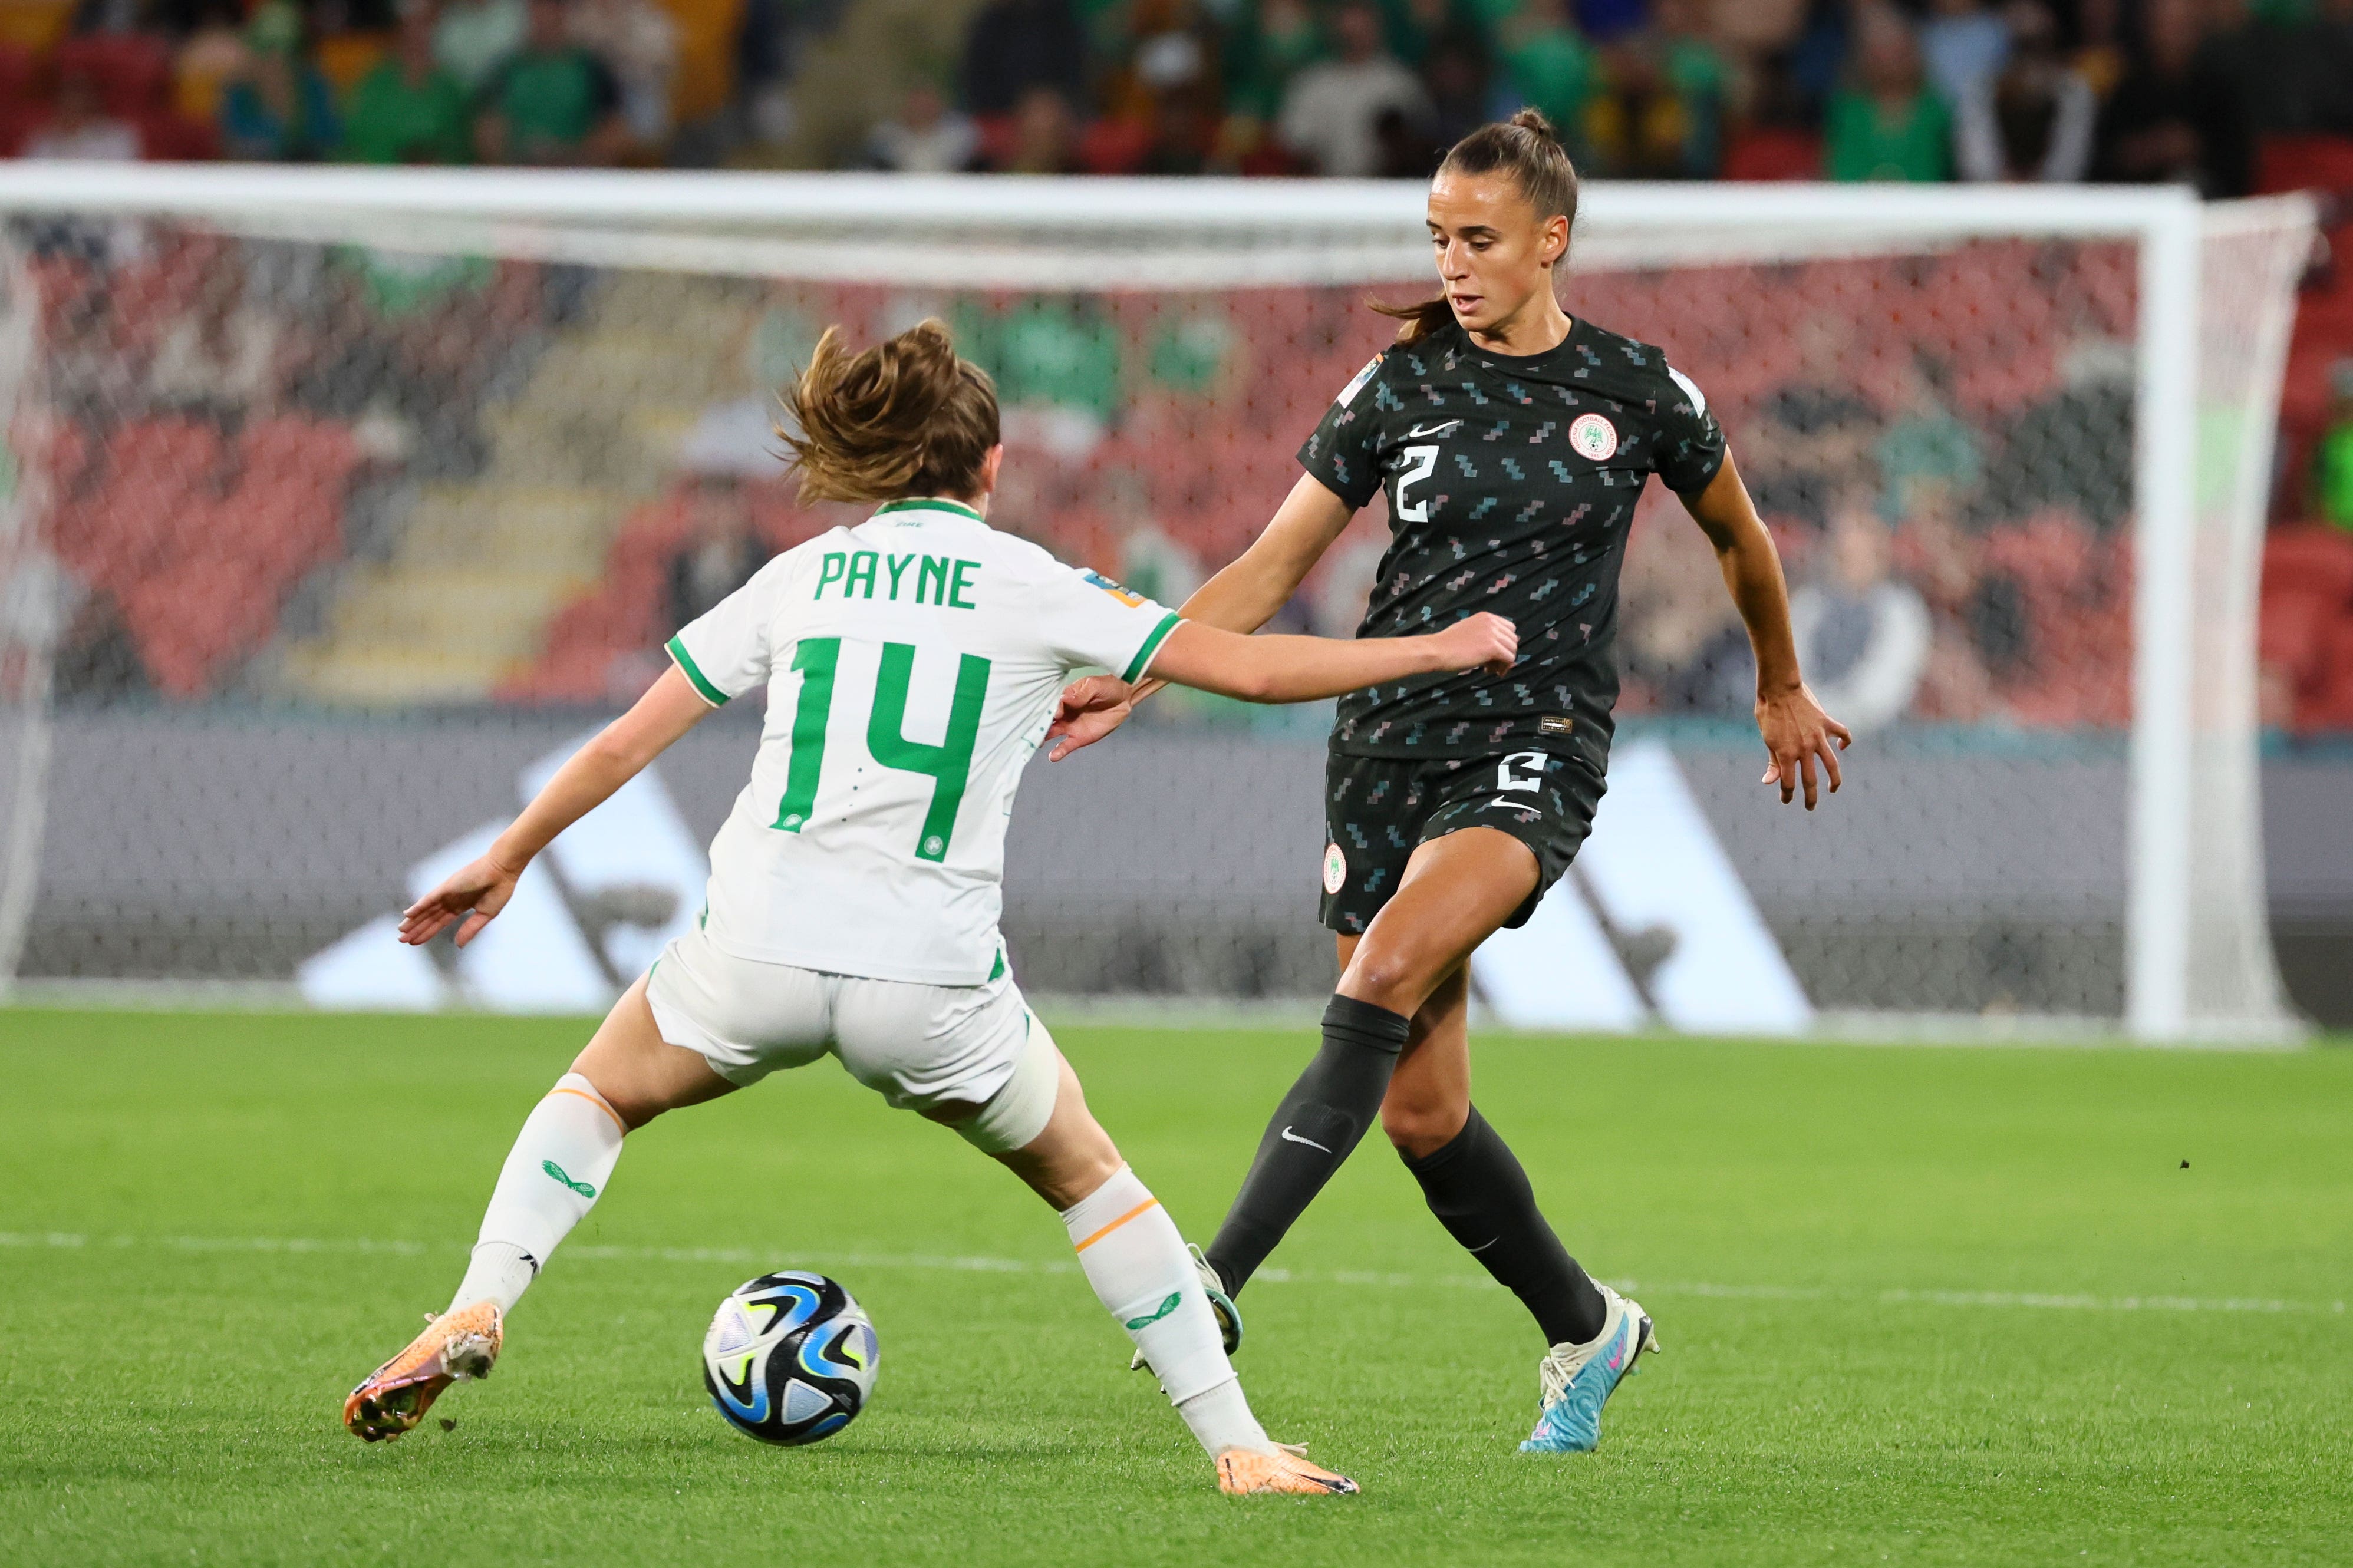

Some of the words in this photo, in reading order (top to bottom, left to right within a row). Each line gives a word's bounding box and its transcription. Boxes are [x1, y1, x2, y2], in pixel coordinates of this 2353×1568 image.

[1572, 427, 1581, 448] NIGERIA
[1576, 416, 1604, 427] FOOTBALL
[1604, 422, 1615, 455] FEDERATION
[1396, 445, 1439, 523] 2
[814, 551, 981, 609] PAYNE
[769, 637, 991, 863] 14
[1497, 752, 1548, 793] 2
